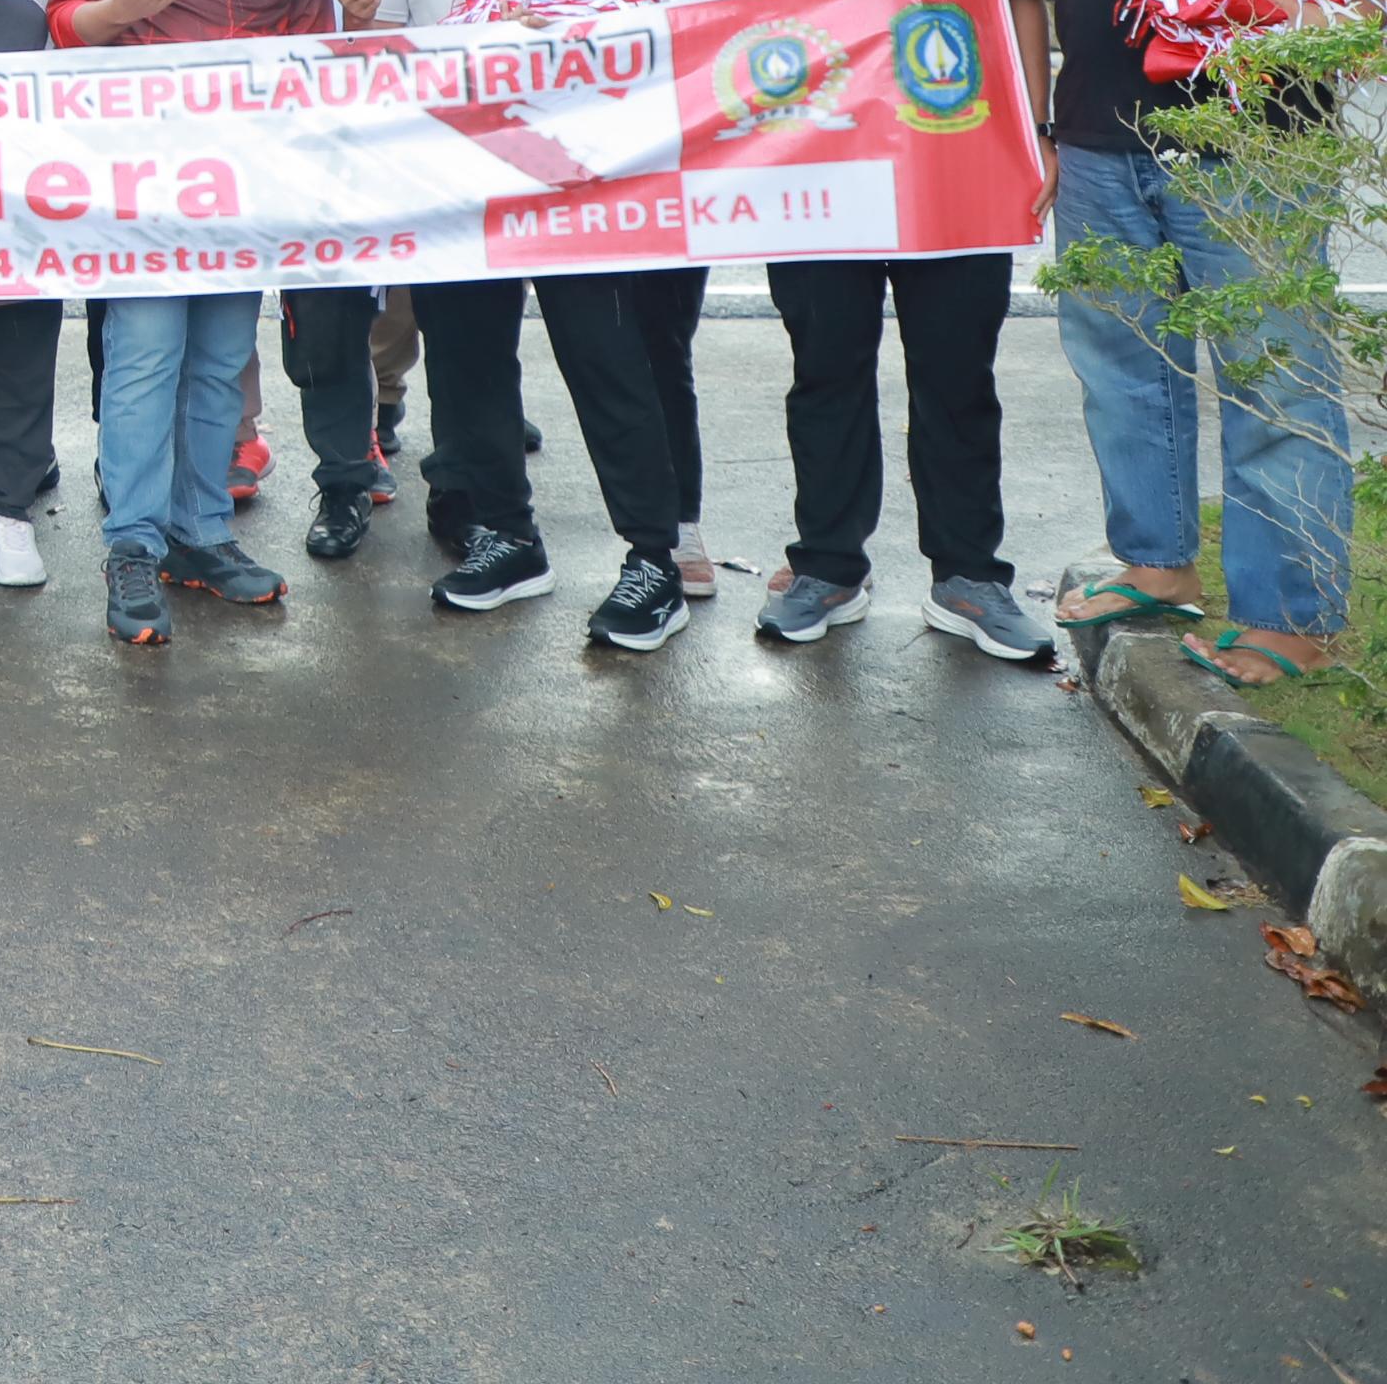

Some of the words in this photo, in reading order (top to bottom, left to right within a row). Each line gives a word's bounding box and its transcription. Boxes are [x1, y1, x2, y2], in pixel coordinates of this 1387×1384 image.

[52, 54, 459, 119] KEPULAUAN
[484, 38, 646, 96] RIAU
[503, 194, 759, 238] MERDEKA
[782, 189, 832, 220] !!!
[38, 242, 257, 286] Agustus
[280, 232, 417, 267] 2025
